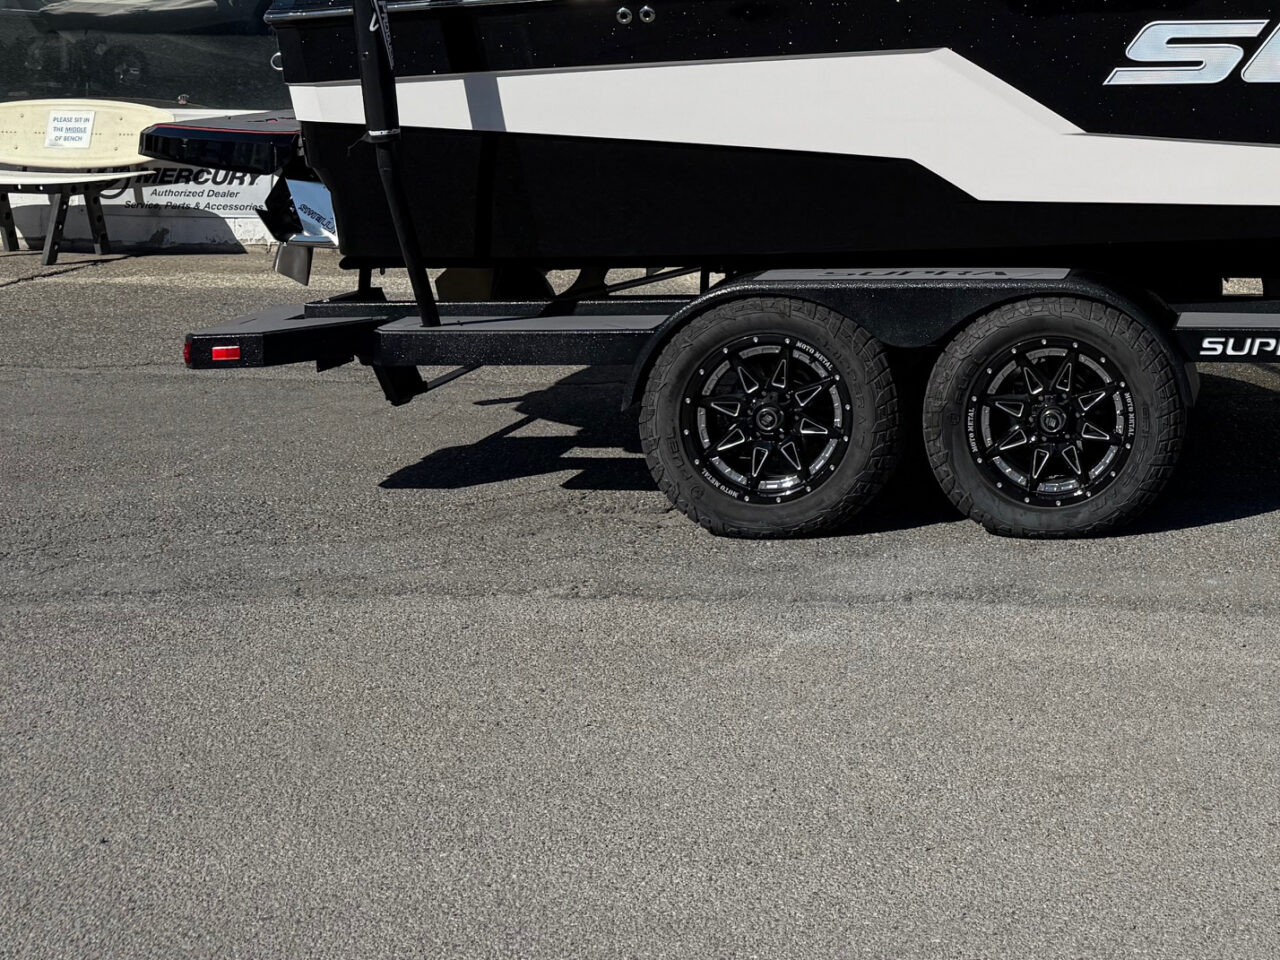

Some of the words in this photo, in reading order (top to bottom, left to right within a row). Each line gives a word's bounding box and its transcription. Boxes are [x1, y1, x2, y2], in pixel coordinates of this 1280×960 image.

[135, 168, 260, 186] MERCURY
[151, 188, 205, 198] Authorized
[207, 188, 240, 198] Dealer
[124, 200, 162, 211] Service,
[165, 201, 191, 210] Parts
[193, 201, 200, 210] &
[204, 201, 264, 211] Accessories
[795, 340, 815, 354] MOTO
[814, 351, 834, 371] METAL
[1124, 392, 1134, 412] MOTO
[967, 407, 975, 432] METAL
[1128, 412, 1136, 437] METAL
[968, 432, 978, 453] MOTO
[702, 467, 721, 487] METAL
[720, 484, 740, 498] MOTO
